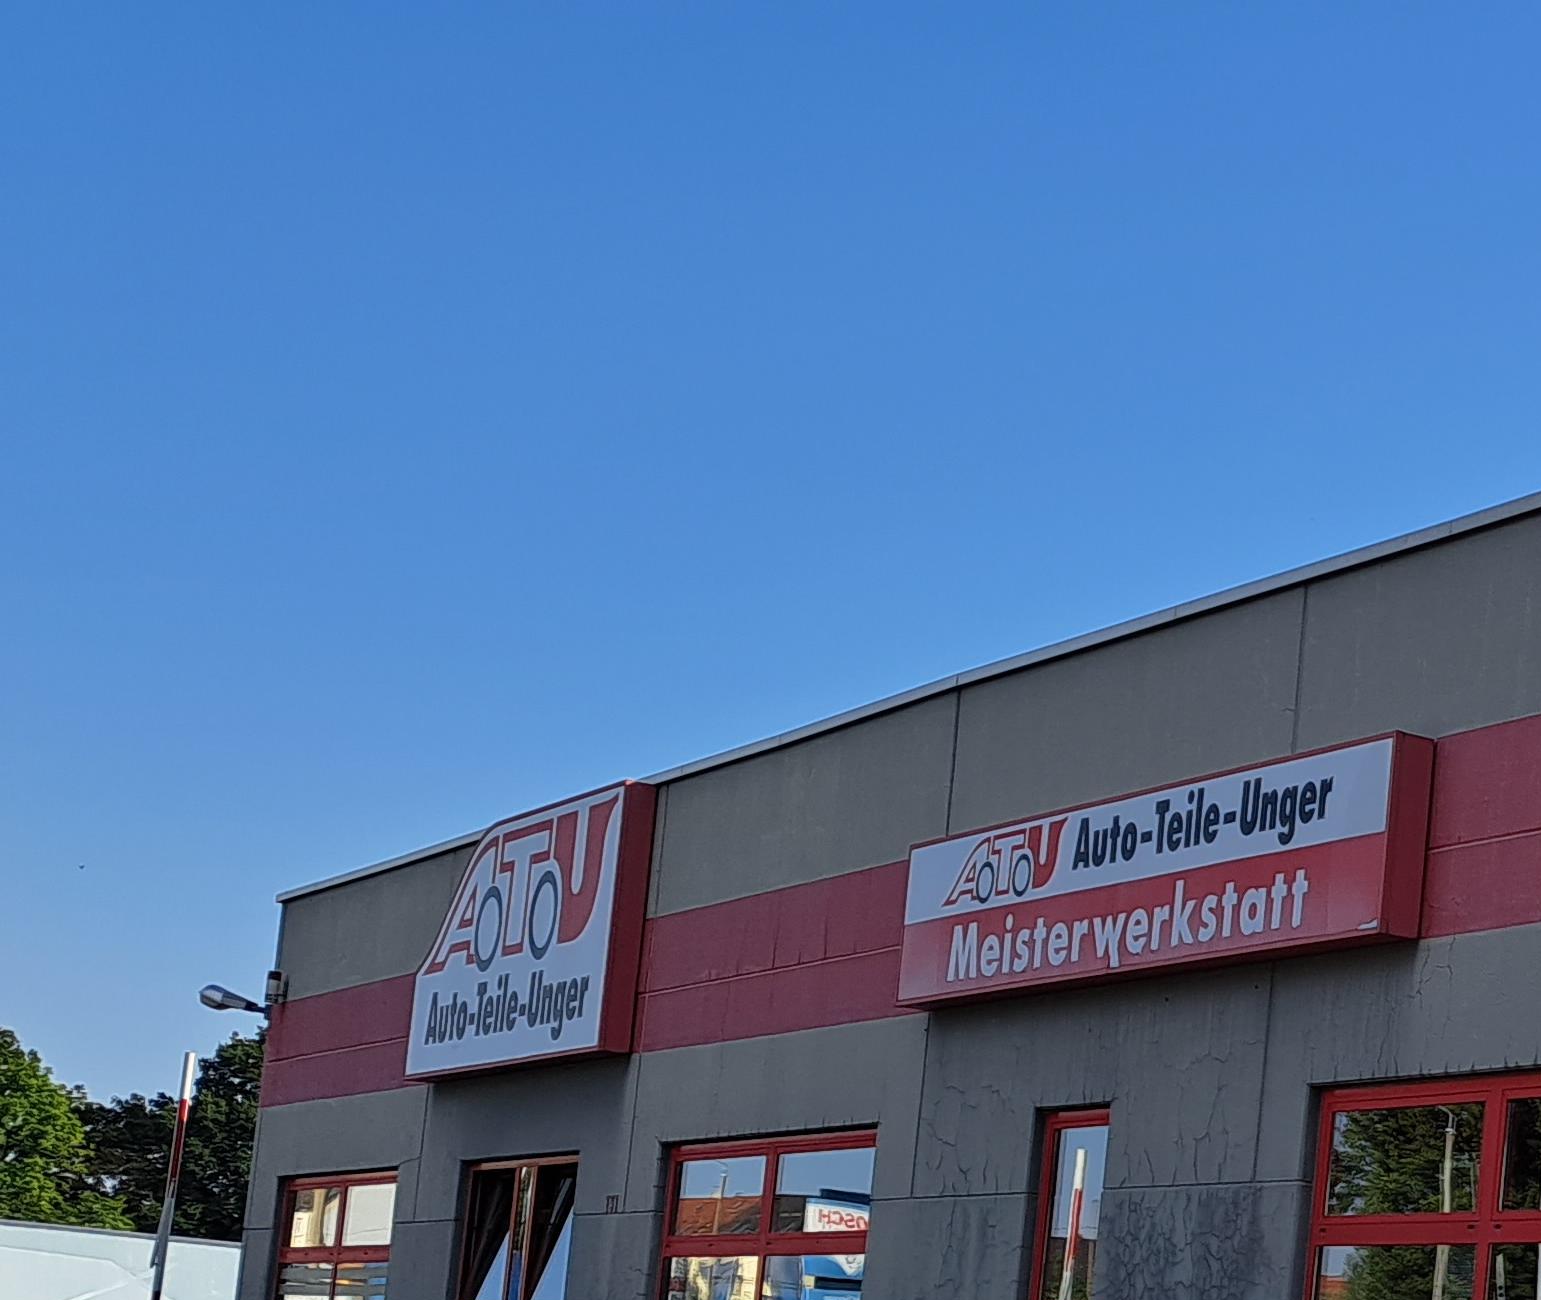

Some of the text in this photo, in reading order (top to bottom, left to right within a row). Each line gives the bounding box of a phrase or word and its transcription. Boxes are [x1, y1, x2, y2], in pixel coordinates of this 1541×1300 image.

[1072, 776, 1333, 871] Auto-Teile-Unger
[945, 869, 1309, 982] Meisterwerkstatt
[424, 969, 590, 1046] Auto-Teile-Unger
